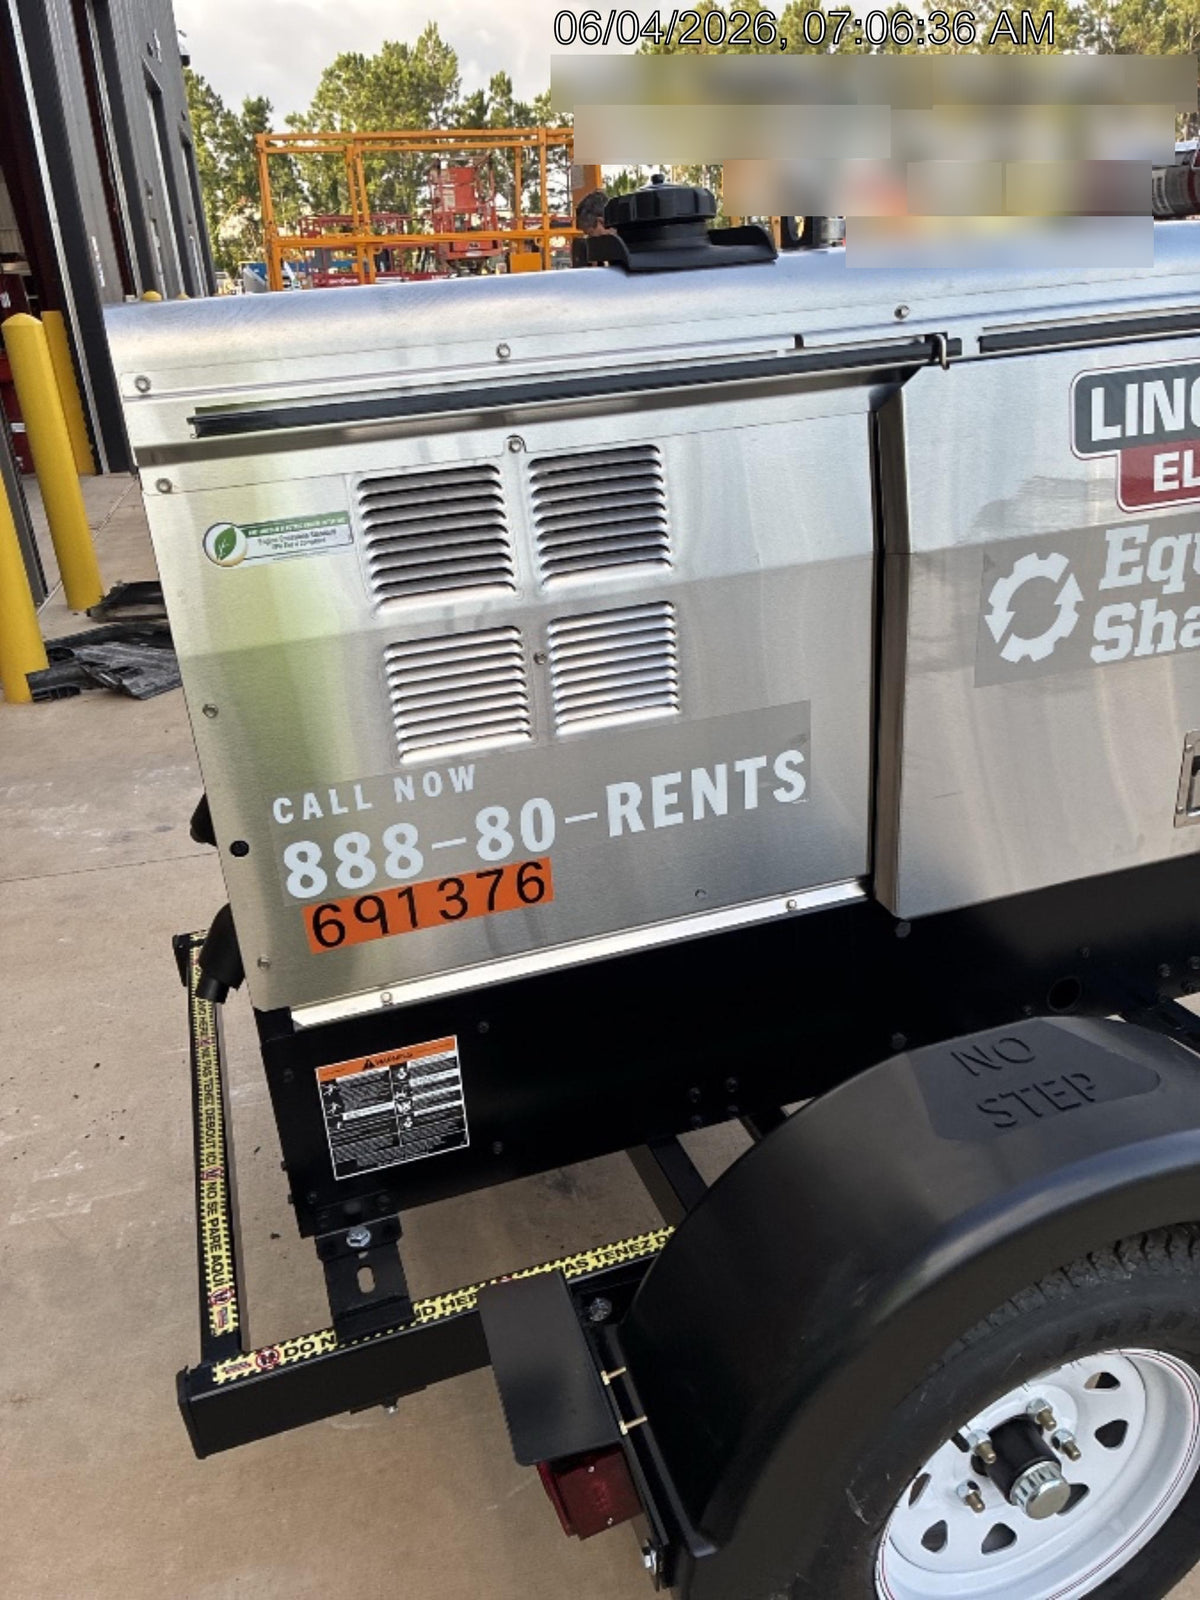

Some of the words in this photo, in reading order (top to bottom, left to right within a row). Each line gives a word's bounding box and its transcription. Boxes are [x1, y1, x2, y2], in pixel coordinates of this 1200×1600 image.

[1090, 376, 1200, 442] LIN
[1098, 524, 1200, 594] Eq
[272, 784, 373, 825] CALL
[393, 764, 476, 803] NOW
[312, 861, 546, 948] 691376
[951, 1037, 1036, 1077] NO
[977, 1073, 1097, 1129] STEP
[206, 1182, 218, 1199] NO
[207, 1202, 219, 1217] SE
[208, 1219, 222, 1252] PARE
[283, 1341, 316, 1358] DO
